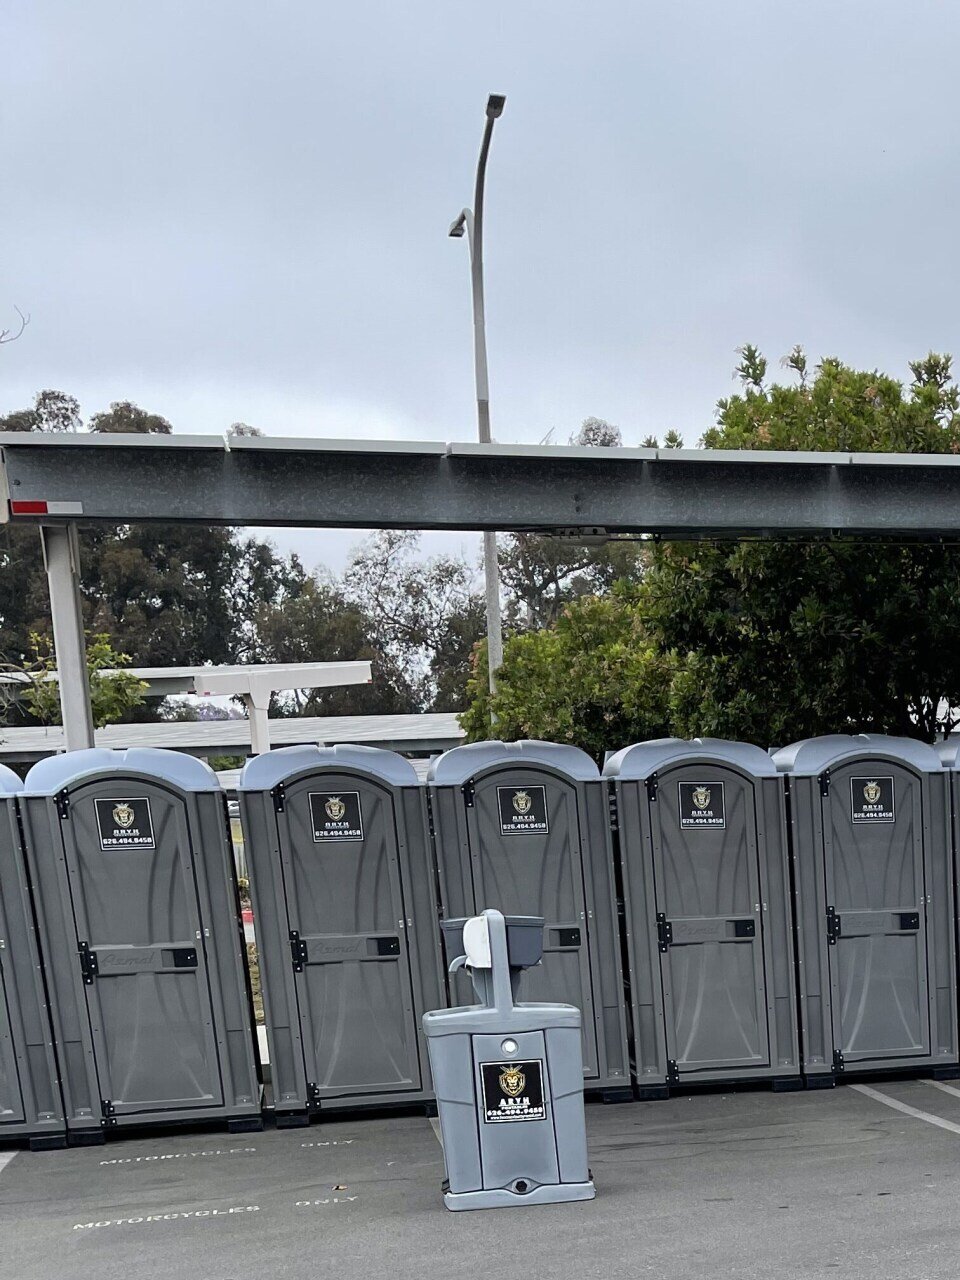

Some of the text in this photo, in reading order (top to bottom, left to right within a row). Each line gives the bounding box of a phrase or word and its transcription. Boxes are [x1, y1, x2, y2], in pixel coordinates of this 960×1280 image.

[100, 1140, 355, 1165] MOTORCYCLES ONLY
[72, 1196, 358, 1230] MOTORCYCLES ONLY
